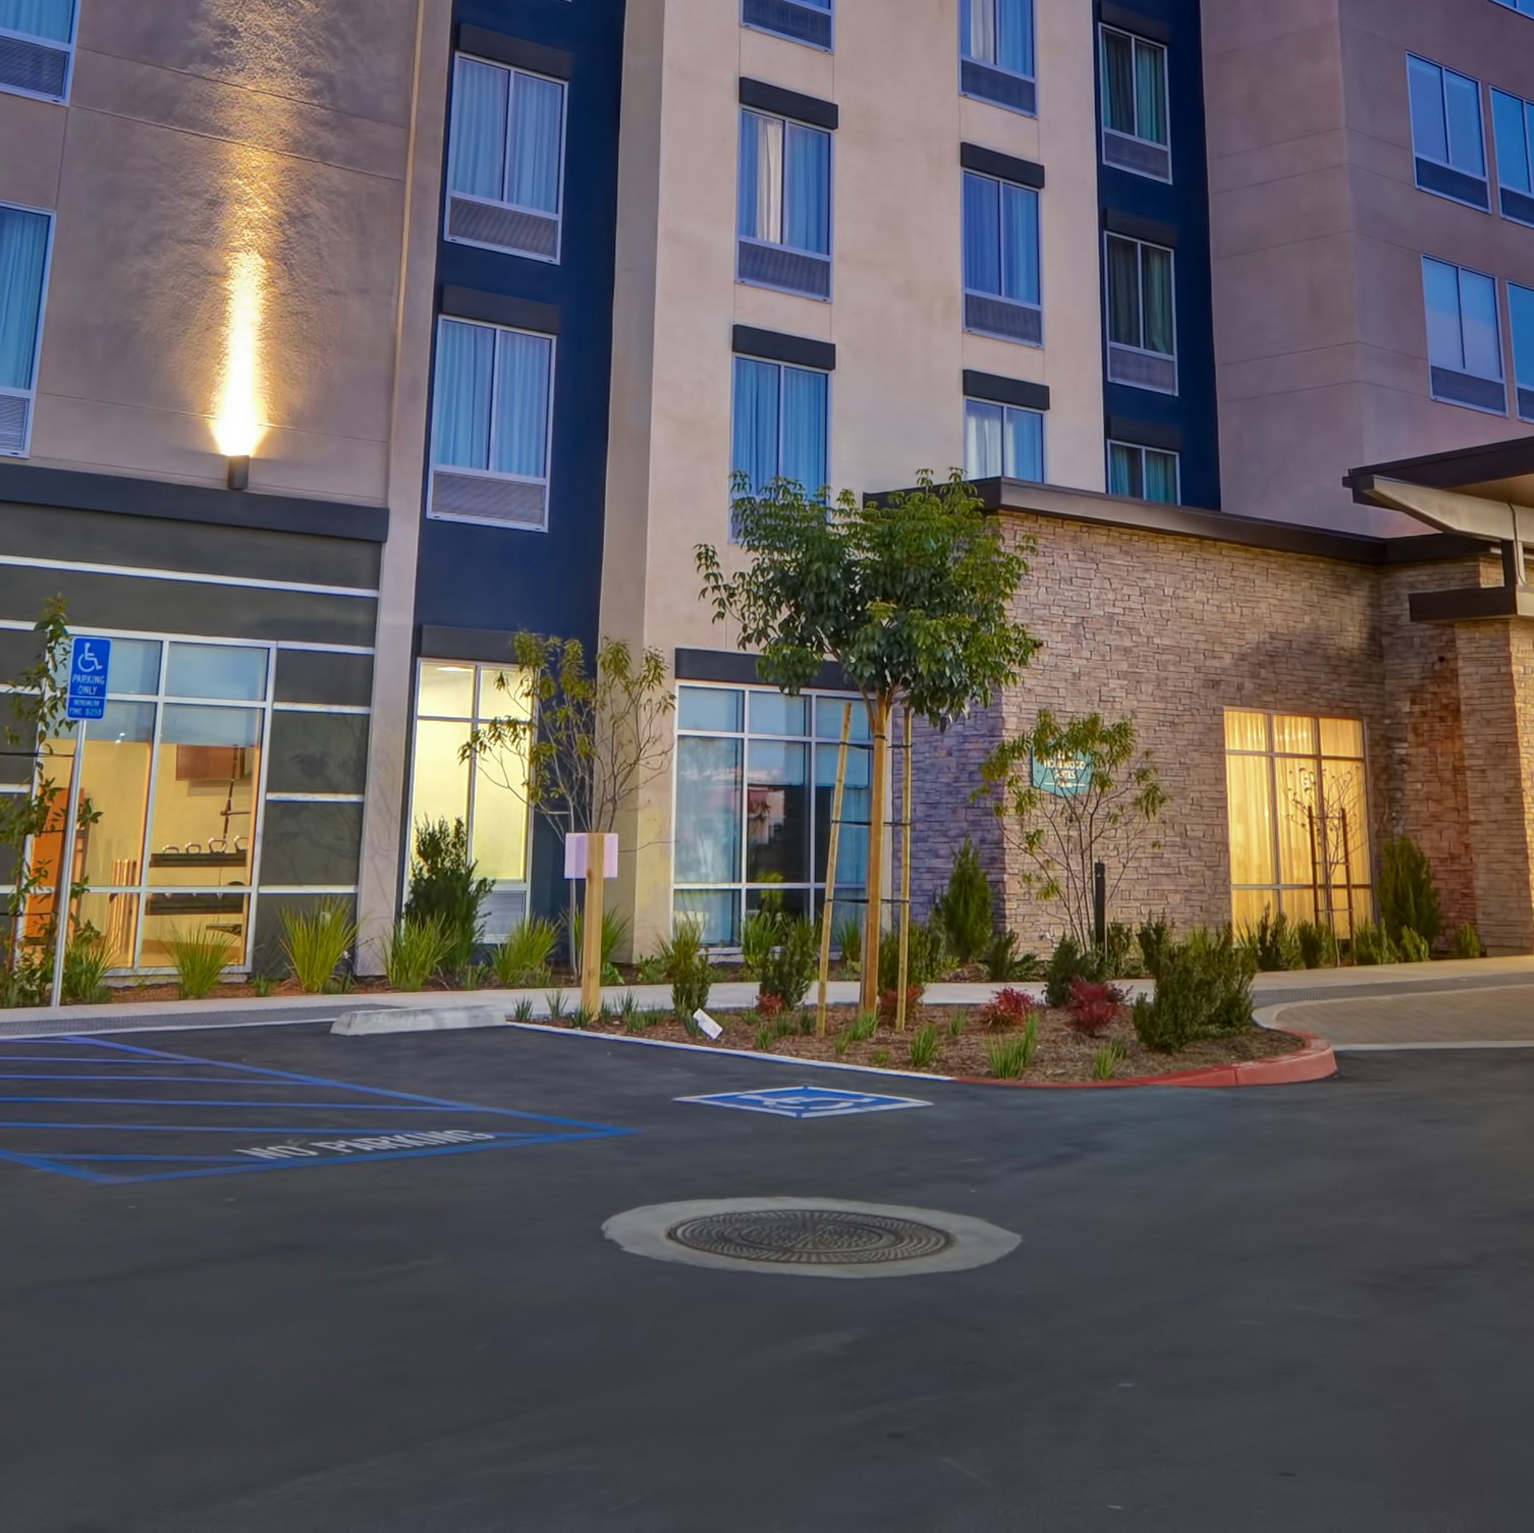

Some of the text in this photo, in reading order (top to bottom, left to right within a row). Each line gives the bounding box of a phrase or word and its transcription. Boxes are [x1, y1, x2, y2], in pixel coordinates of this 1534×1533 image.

[72, 674, 105, 685] PARKING
[77, 685, 98, 695] ONLY
[233, 1129, 496, 1159] NO PARKING
